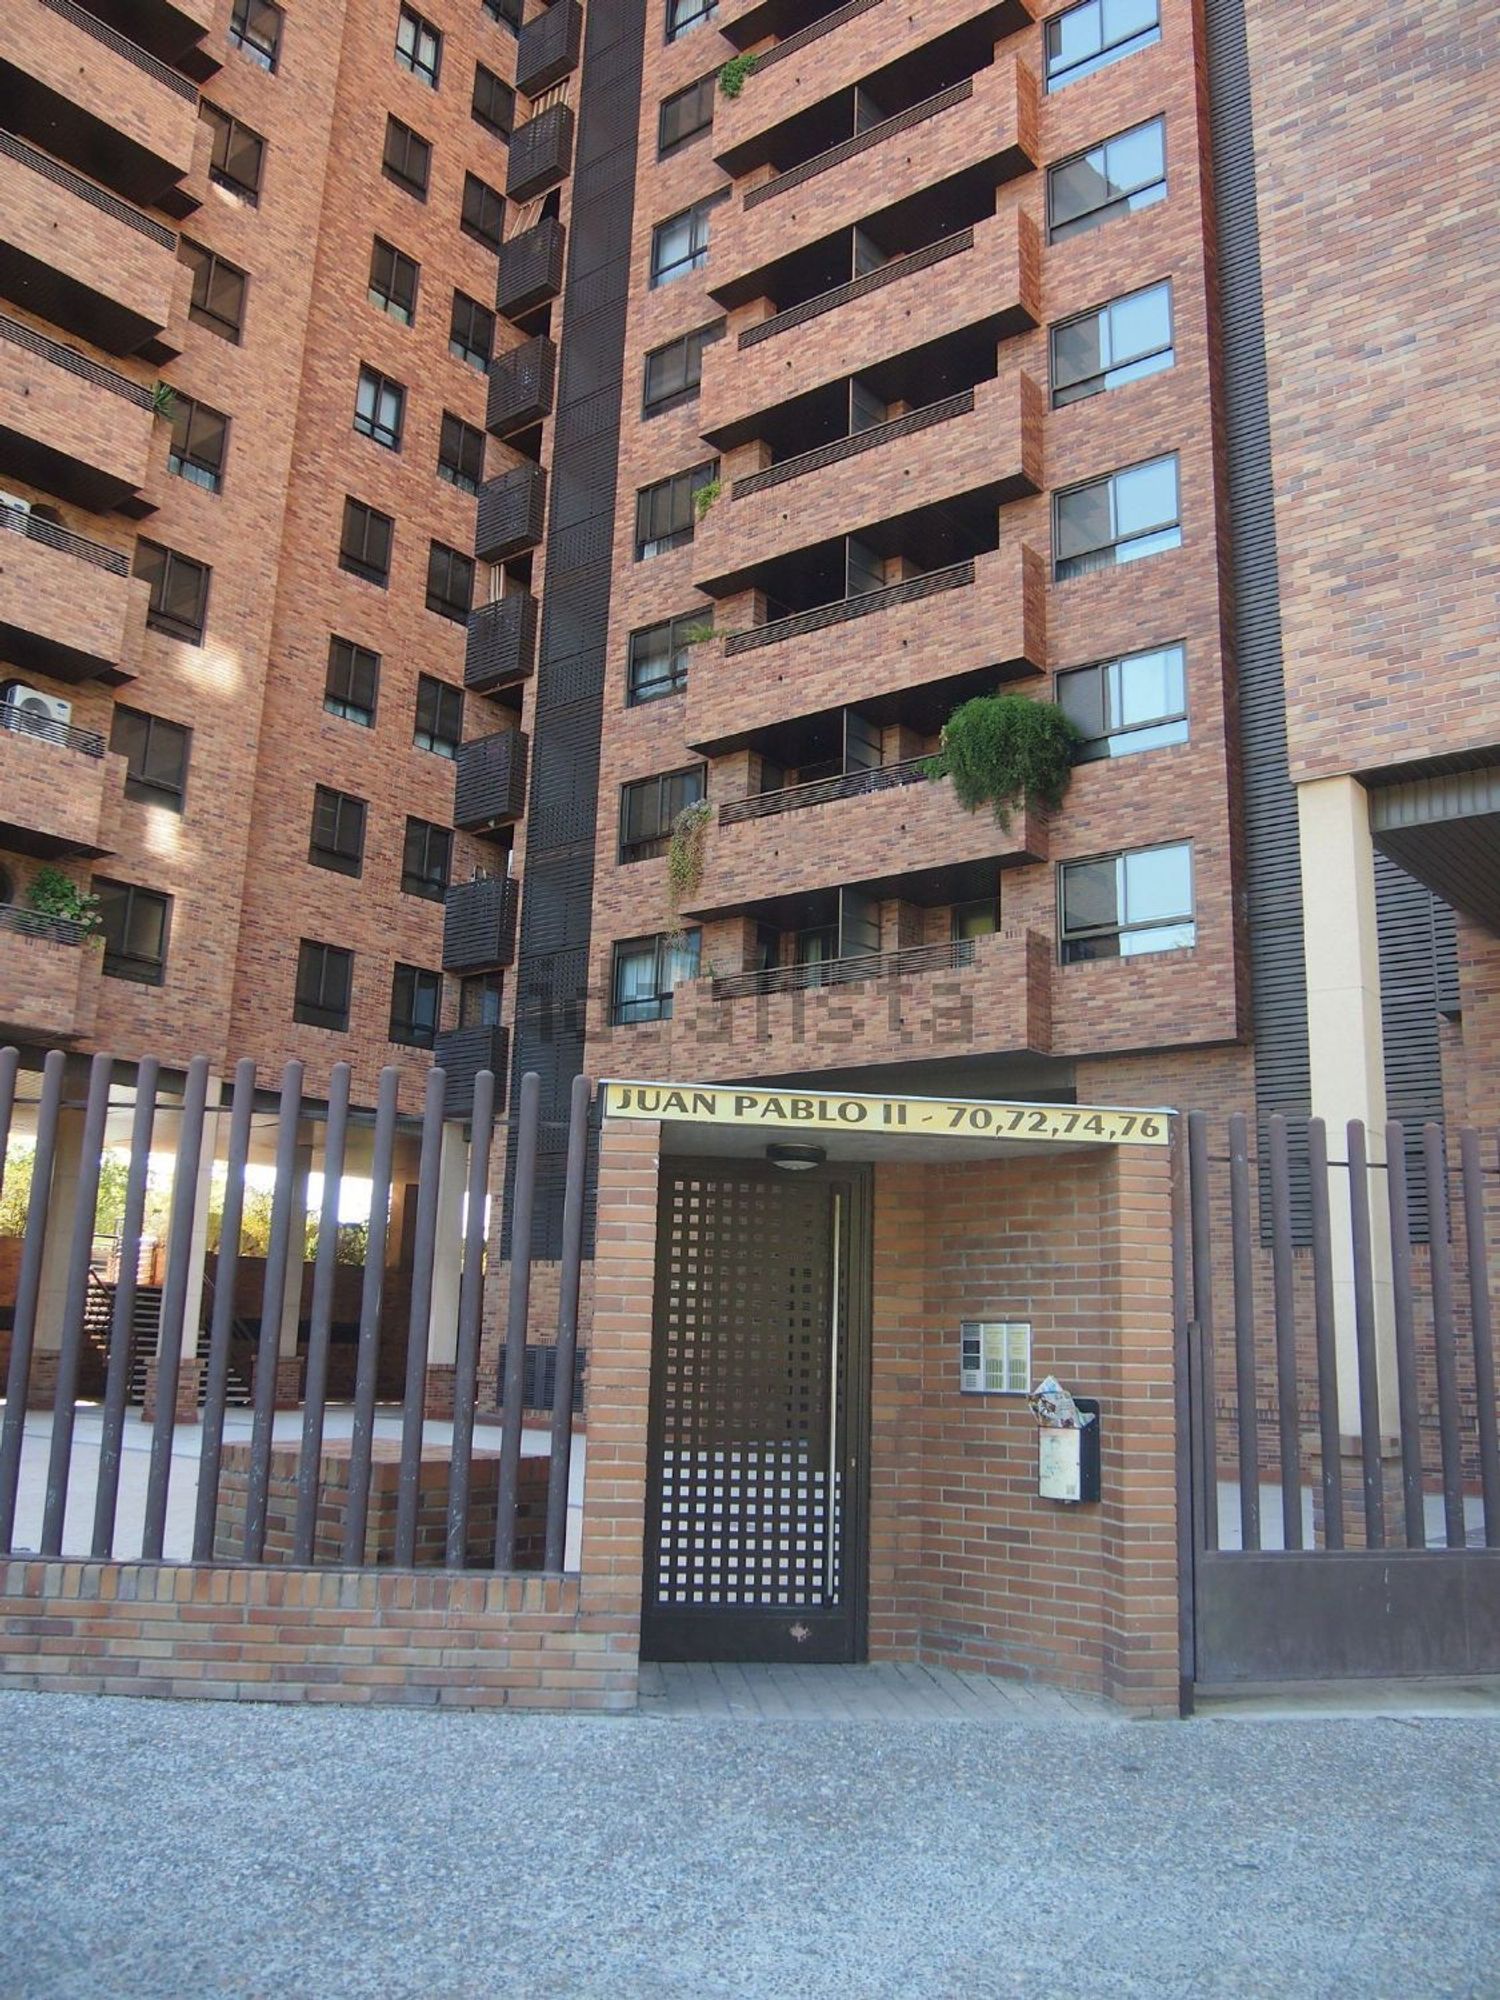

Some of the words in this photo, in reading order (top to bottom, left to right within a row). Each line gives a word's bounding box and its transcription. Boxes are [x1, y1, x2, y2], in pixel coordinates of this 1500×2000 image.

[616, 1088, 716, 1115] JUAN
[734, 1095, 868, 1123] PABLO
[883, 1104, 907, 1125] II
[946, 1106, 1160, 1140] 70,72,74,76
